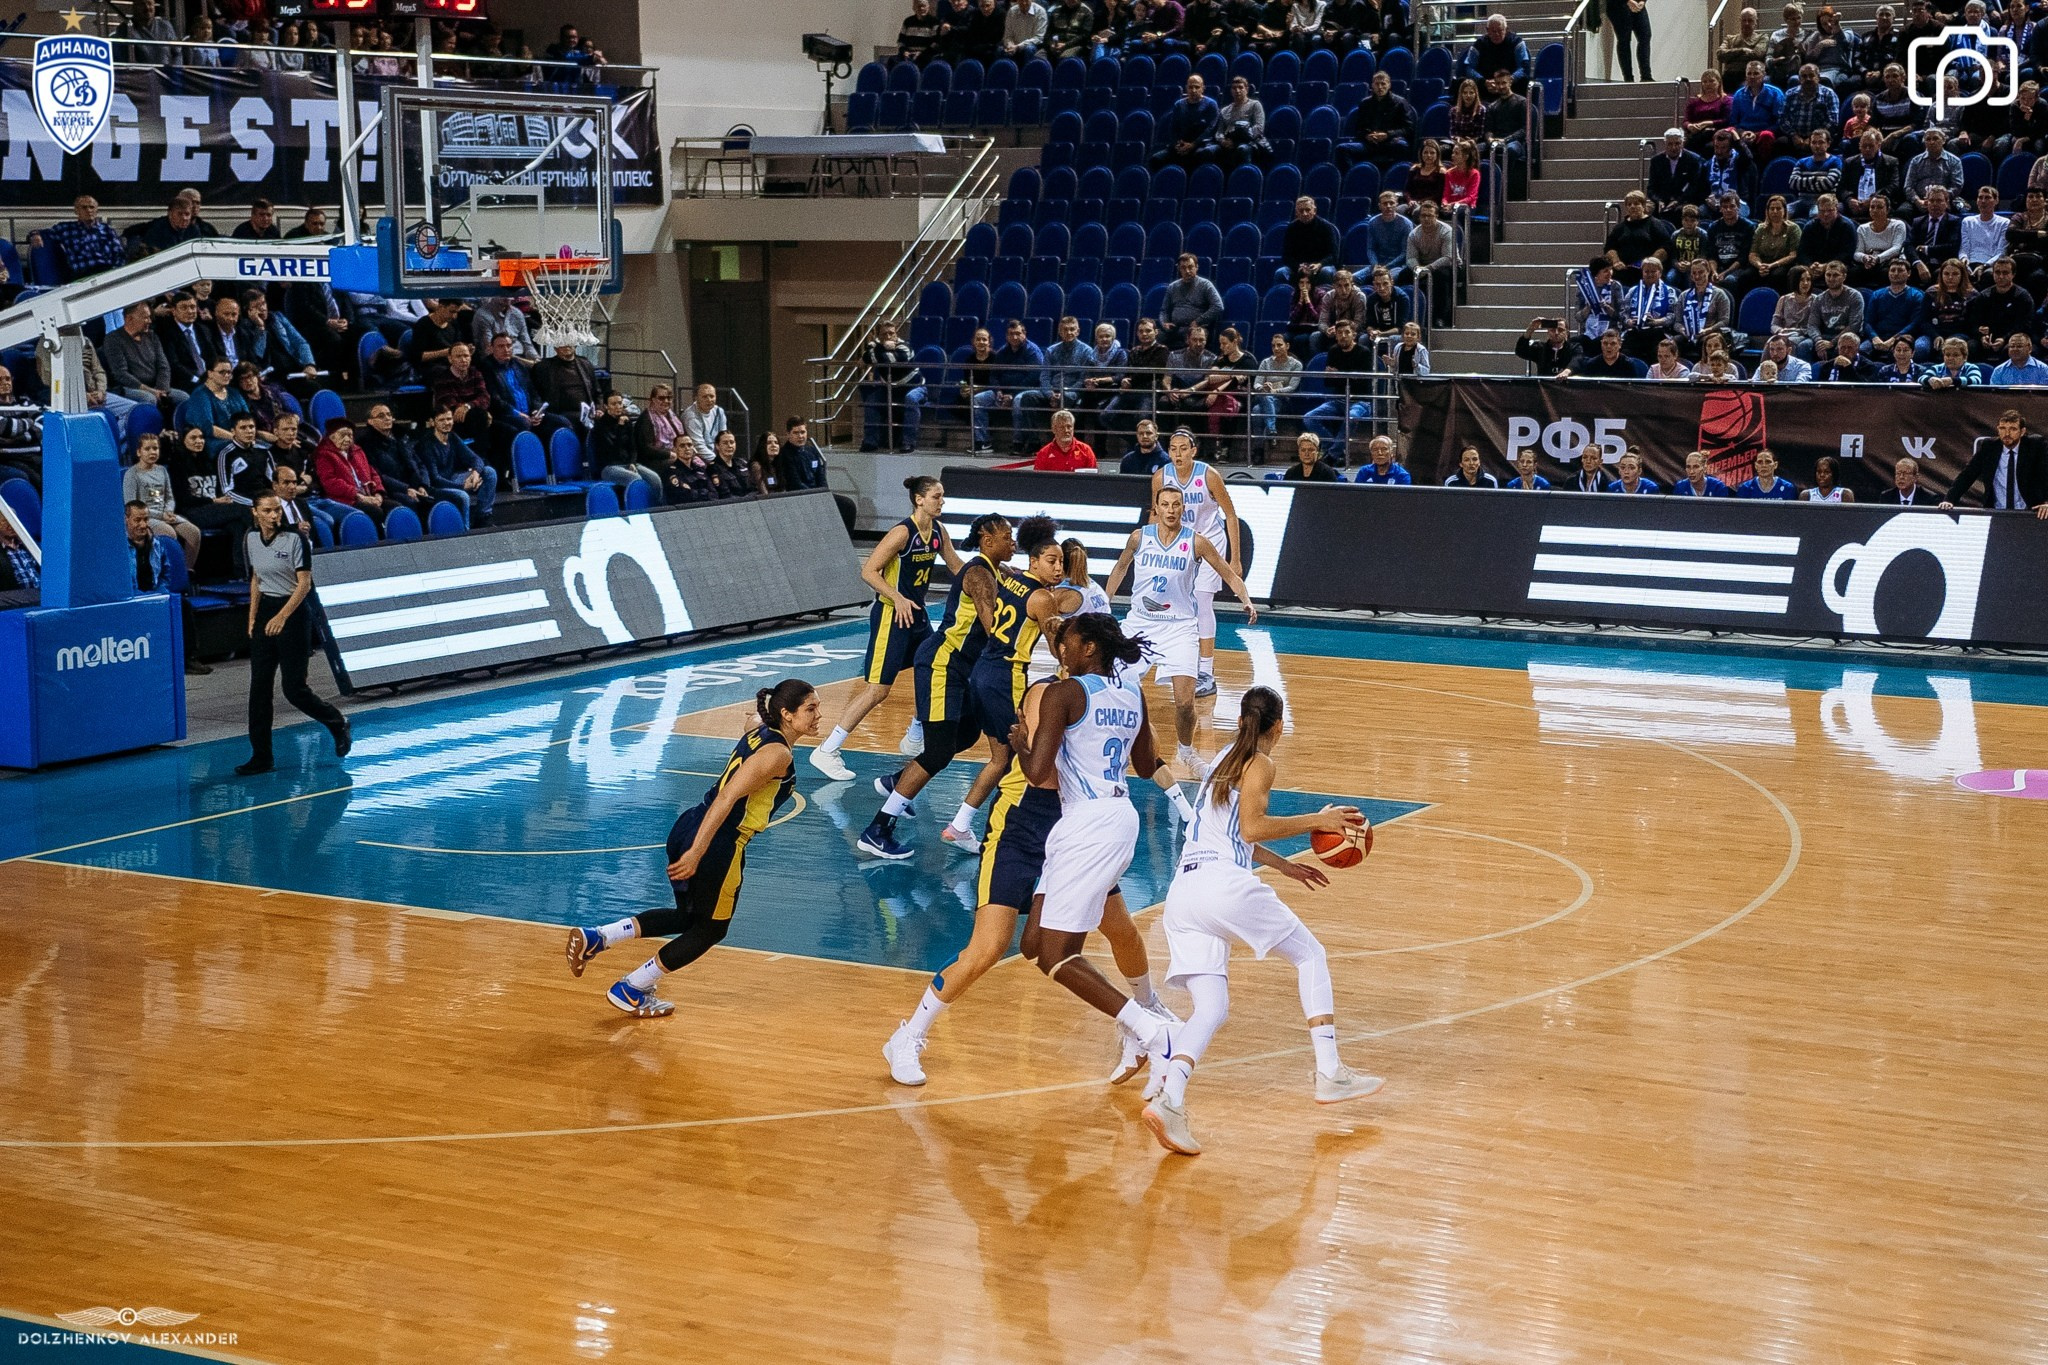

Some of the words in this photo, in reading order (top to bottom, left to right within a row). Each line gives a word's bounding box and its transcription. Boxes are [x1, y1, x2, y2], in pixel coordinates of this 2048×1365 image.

[591, 170, 653, 187] КПЛЕКС
[238, 257, 331, 278] GARED
[1506, 416, 1628, 464] РФБ
[1141, 552, 1187, 571] DYNAMO
[913, 567, 931, 587] 24
[1152, 575, 1168, 593] 12
[56, 636, 150, 671] molten
[1102, 737, 1131, 783] 3
